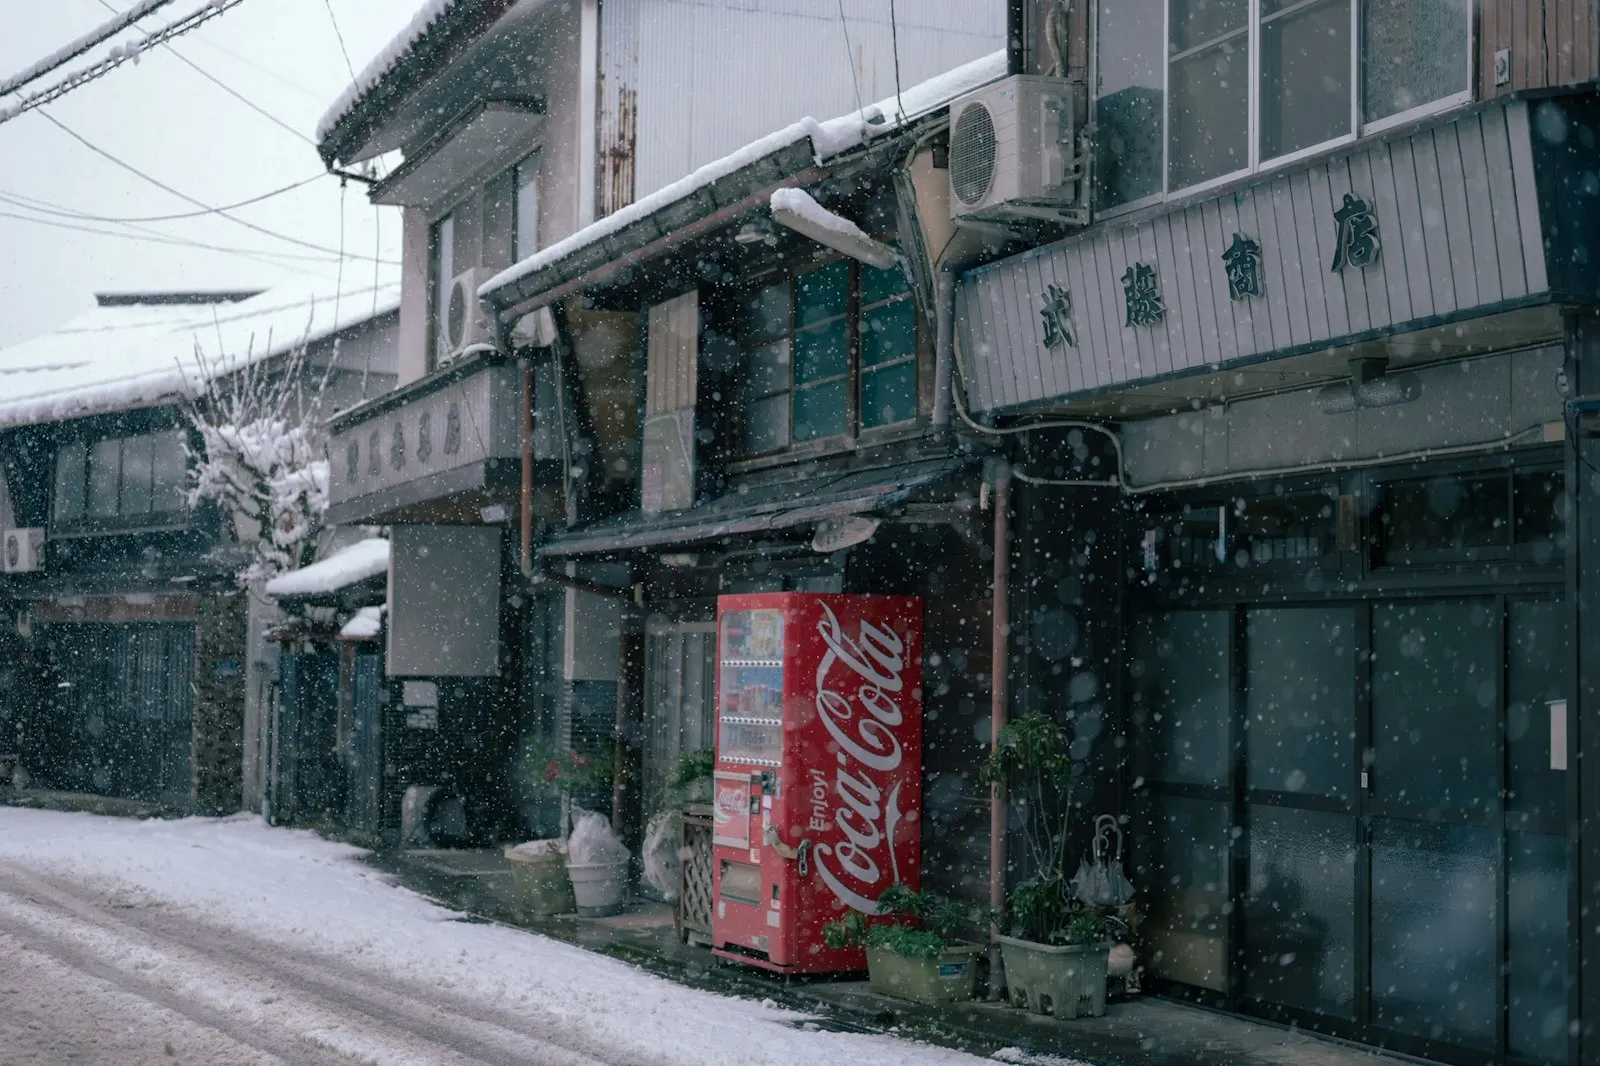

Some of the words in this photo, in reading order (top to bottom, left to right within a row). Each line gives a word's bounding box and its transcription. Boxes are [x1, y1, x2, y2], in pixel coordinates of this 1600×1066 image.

[1039, 191, 1382, 350] 武藤商店
[809, 768, 829, 832] Enjoy!
[813, 598, 903, 916] Coca-Cola
